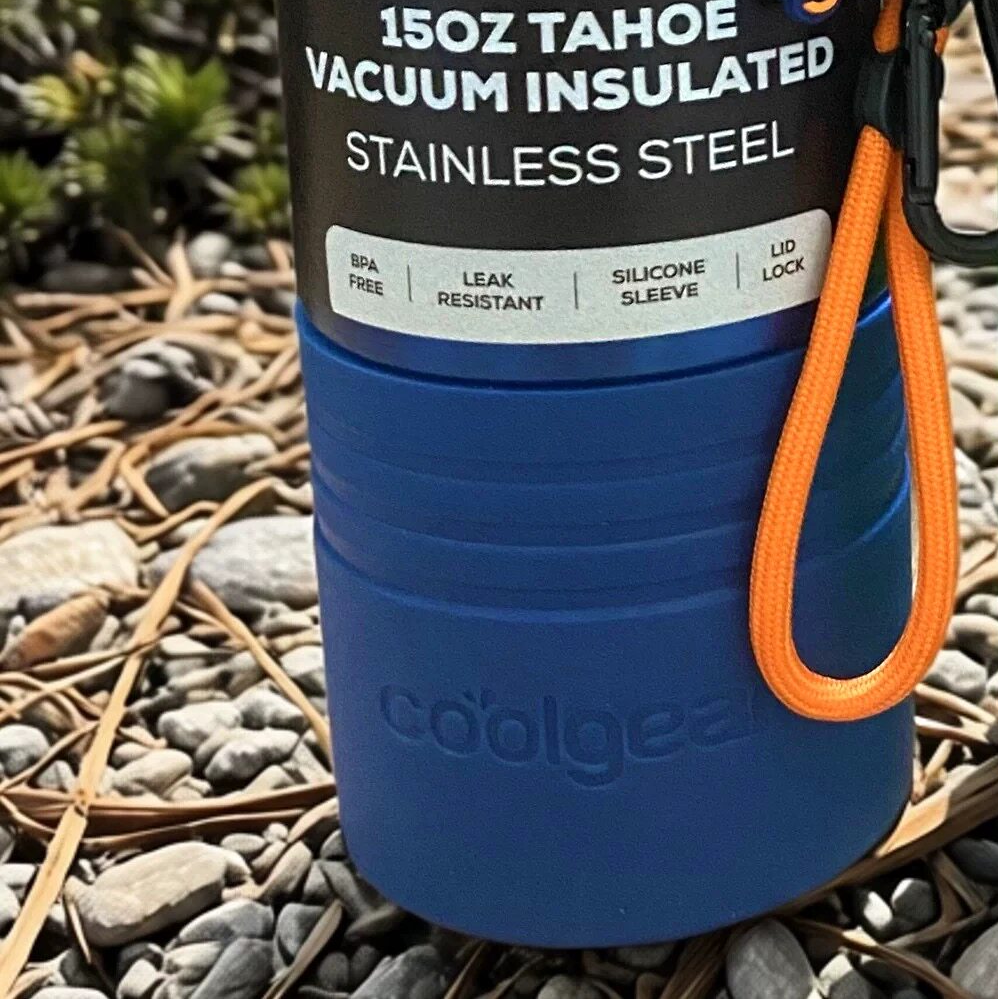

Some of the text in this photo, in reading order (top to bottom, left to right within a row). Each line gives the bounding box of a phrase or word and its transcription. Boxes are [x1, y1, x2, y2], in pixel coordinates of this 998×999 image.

[380, 6, 517, 54] 15OZ
[304, 35, 836, 113] VACUUM INSULATED
[346, 120, 795, 187] STAINLESS STEEL
[770, 238, 796, 258] LID
[350, 252, 380, 275] BPA
[611, 258, 706, 285] SILICONE
[762, 257, 805, 282] LOCK
[349, 275, 384, 297] FREE
[463, 271, 514, 289] LEAK
[437, 291, 544, 311] RESISTANT
[621, 282, 699, 306] SLEEVE
[380, 684, 760, 790] coolgea
